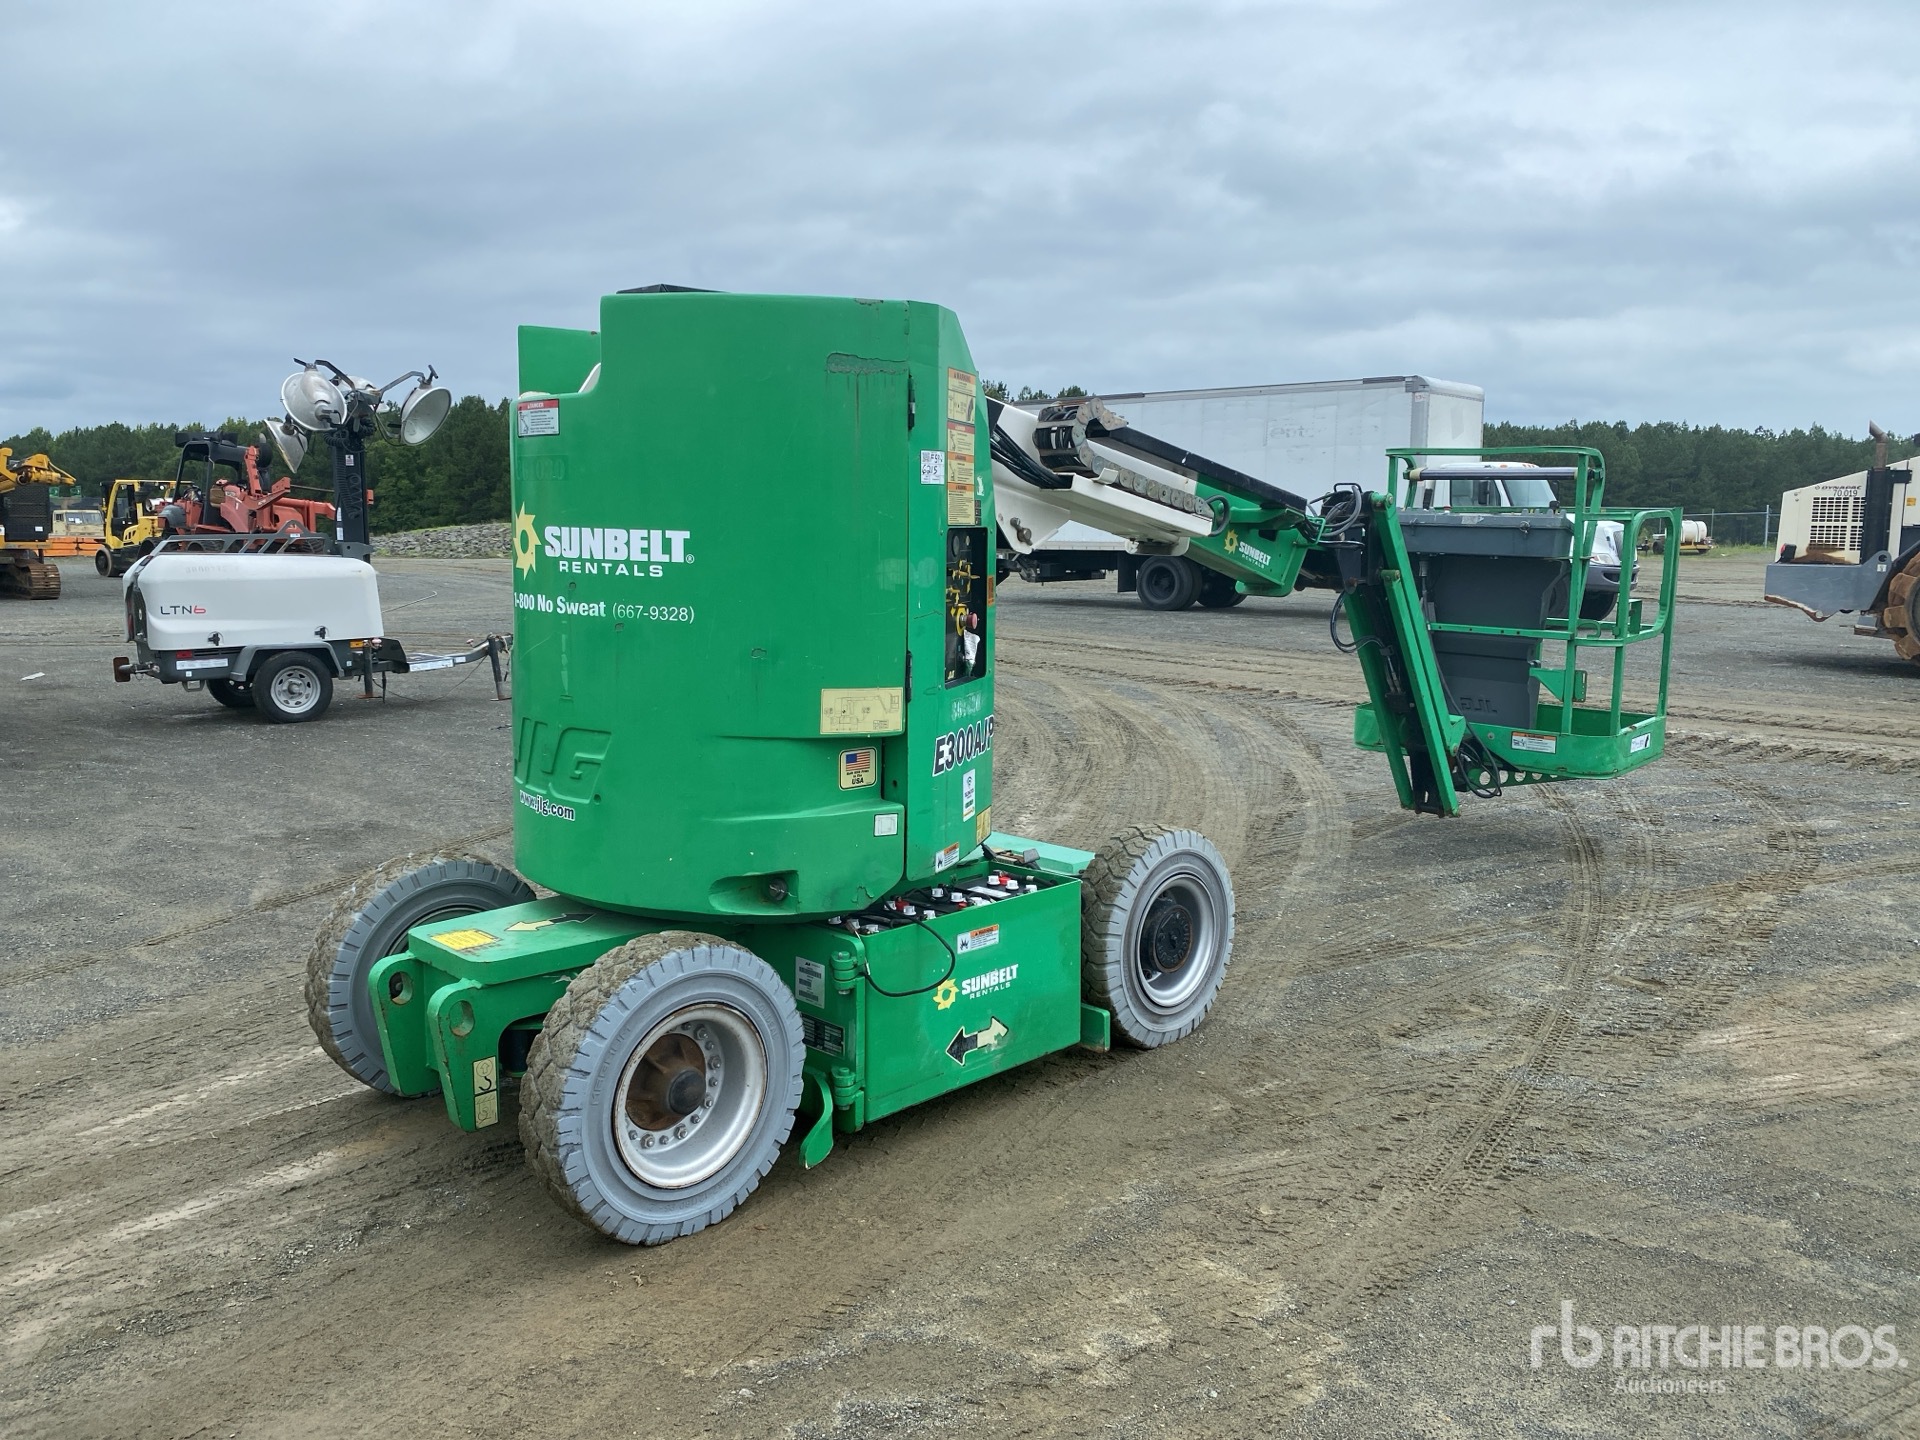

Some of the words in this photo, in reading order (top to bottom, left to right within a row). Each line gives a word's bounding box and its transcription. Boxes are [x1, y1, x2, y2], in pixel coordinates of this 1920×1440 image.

[544, 526, 690, 563] SUNBELT
[1238, 541, 1272, 566] SUNBELT
[559, 561, 663, 577] RENTALS
[160, 605, 206, 615] LTN6
[537, 594, 553, 613] No
[556, 596, 606, 617] Sweat
[612, 603, 695, 624] (667-9328)
[932, 714, 994, 777] E300AJP
[851, 777, 864, 785] USA
[961, 963, 1019, 995] SUNBELT
[969, 981, 1011, 1000] RENTALS
